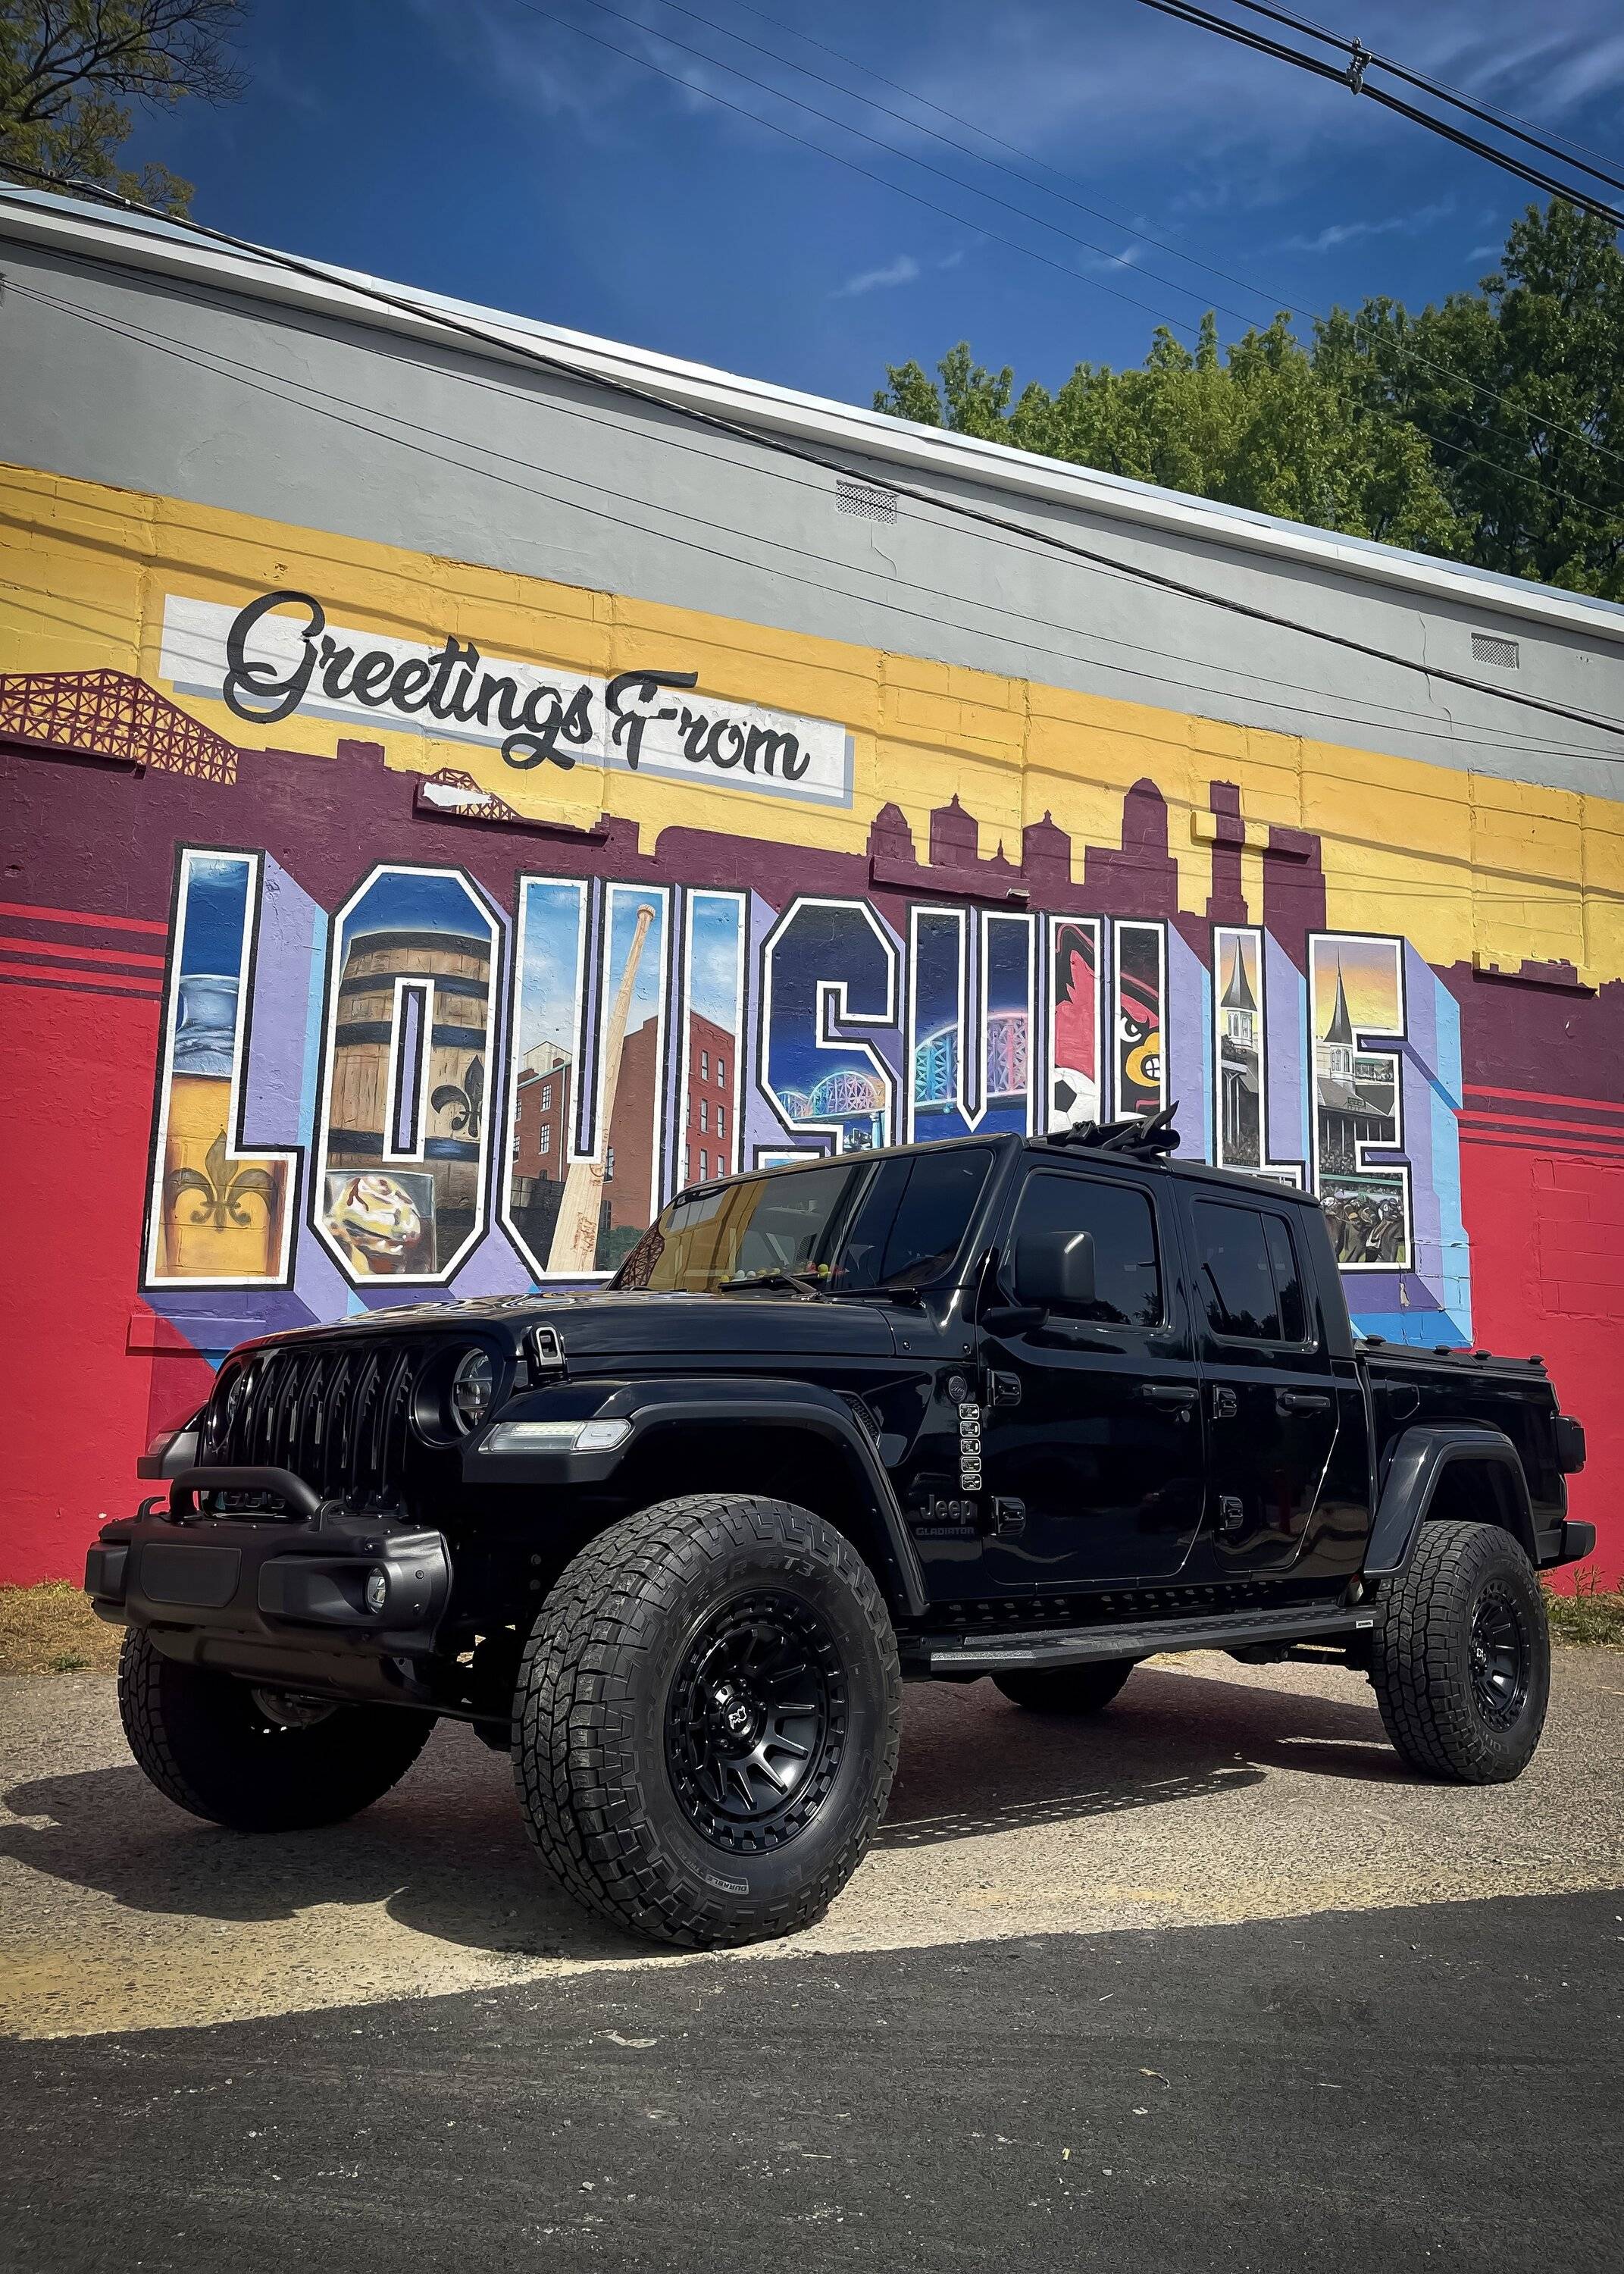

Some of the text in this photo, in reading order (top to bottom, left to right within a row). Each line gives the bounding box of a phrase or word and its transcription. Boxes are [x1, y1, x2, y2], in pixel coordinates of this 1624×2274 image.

[224, 590, 811, 781] Greetings From
[139, 841, 1415, 1292] LOUISVILLE
[915, 1527, 975, 1536] GLADIATOR
[920, 1494, 977, 1524] Jeep
